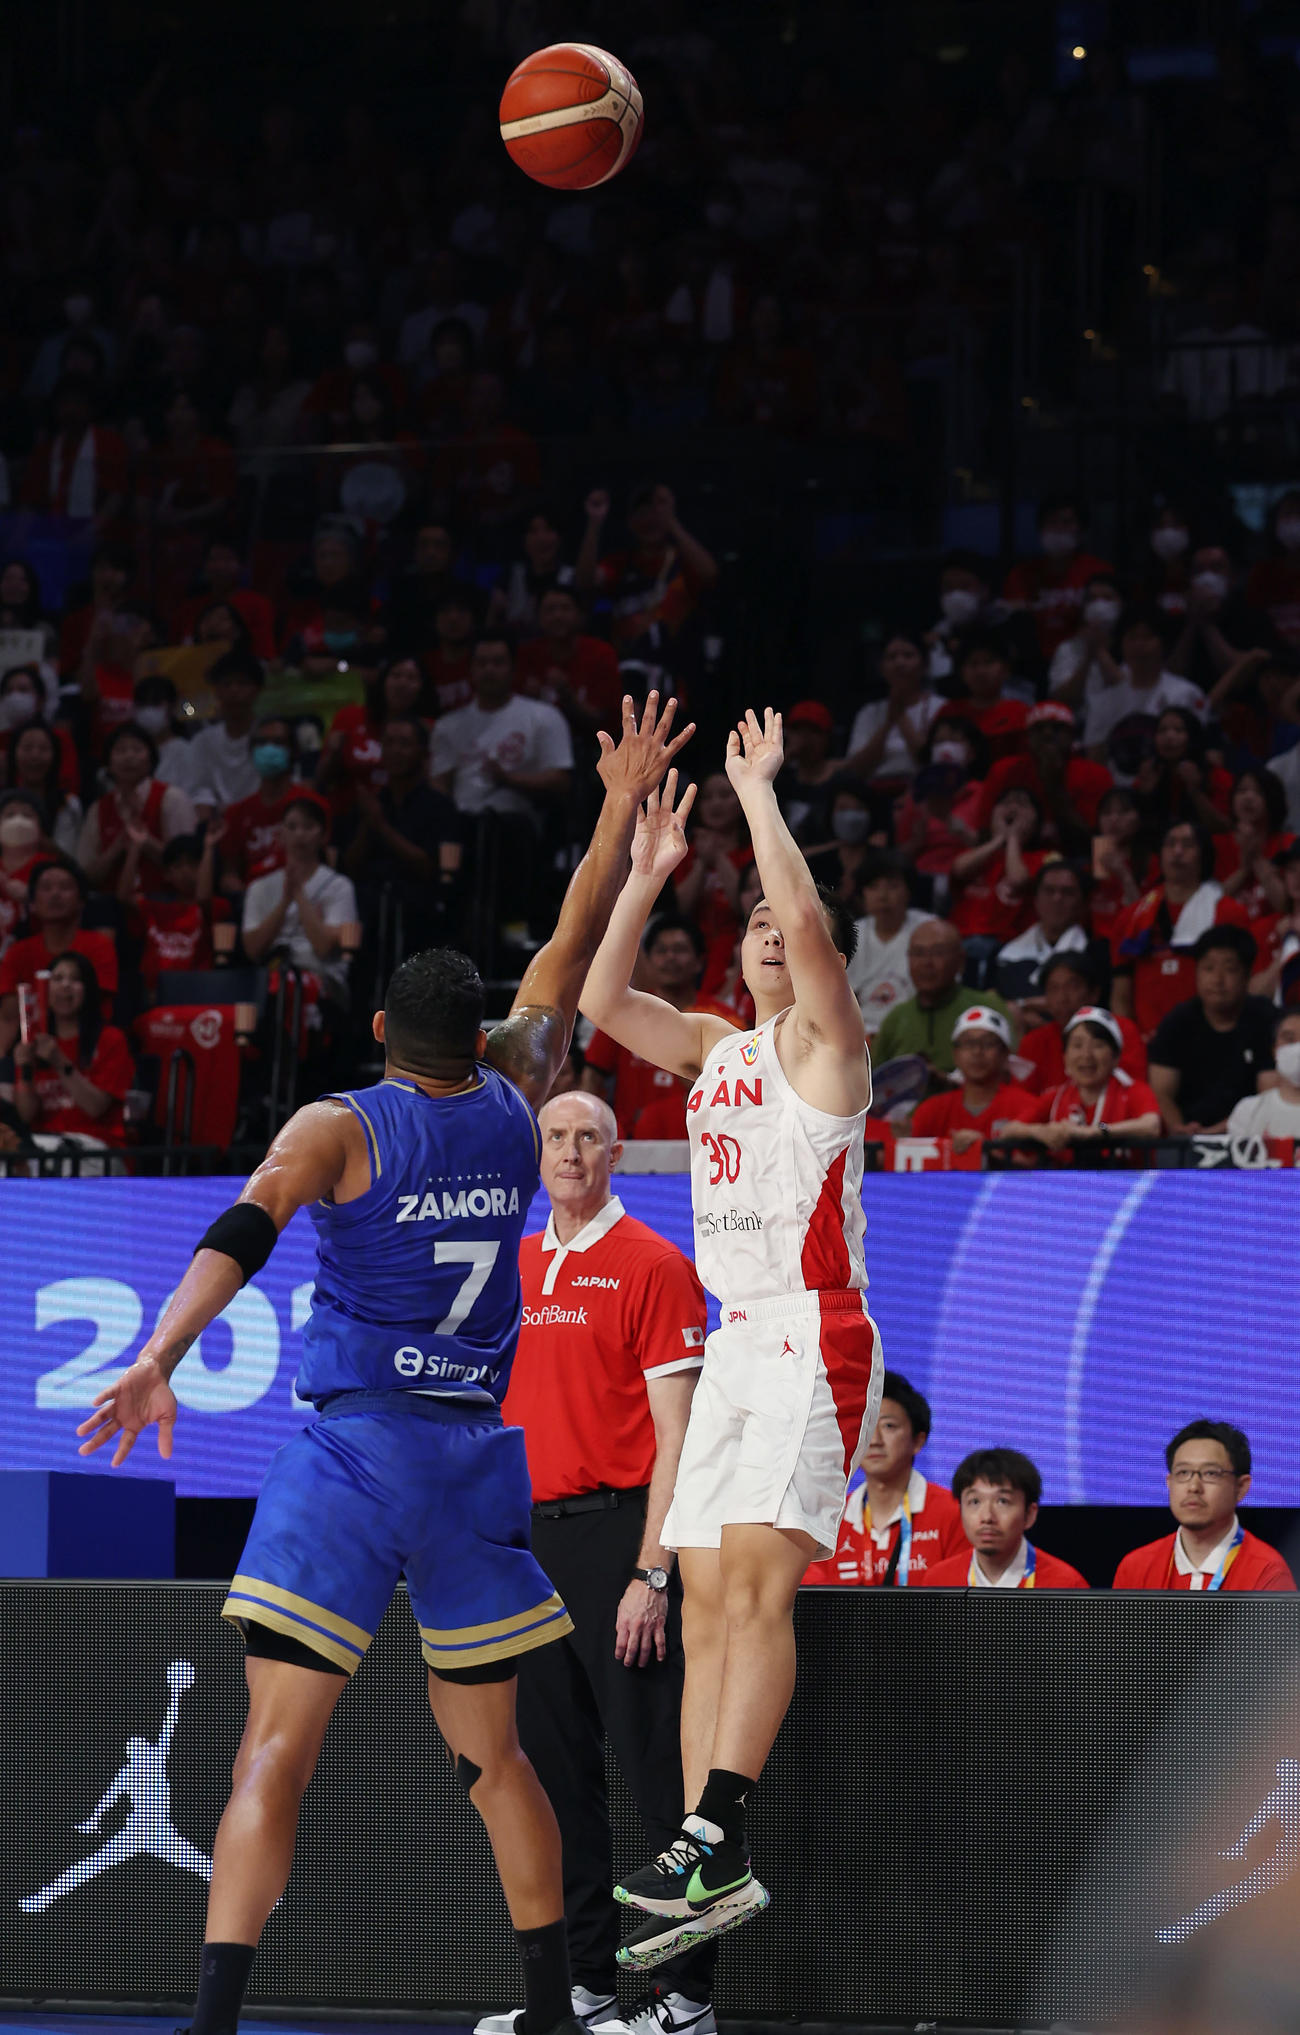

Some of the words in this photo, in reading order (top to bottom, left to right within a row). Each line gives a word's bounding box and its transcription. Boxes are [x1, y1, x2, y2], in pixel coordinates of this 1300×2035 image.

[701, 1132, 742, 1185] 30
[396, 1187, 519, 1223] ZAMORA
[433, 1240, 501, 1336] 7
[571, 1276, 620, 1290] JAPAN
[521, 1304, 588, 1326] SoftBank
[728, 1310, 747, 1323] JPN
[35, 1277, 316, 1412] 20
